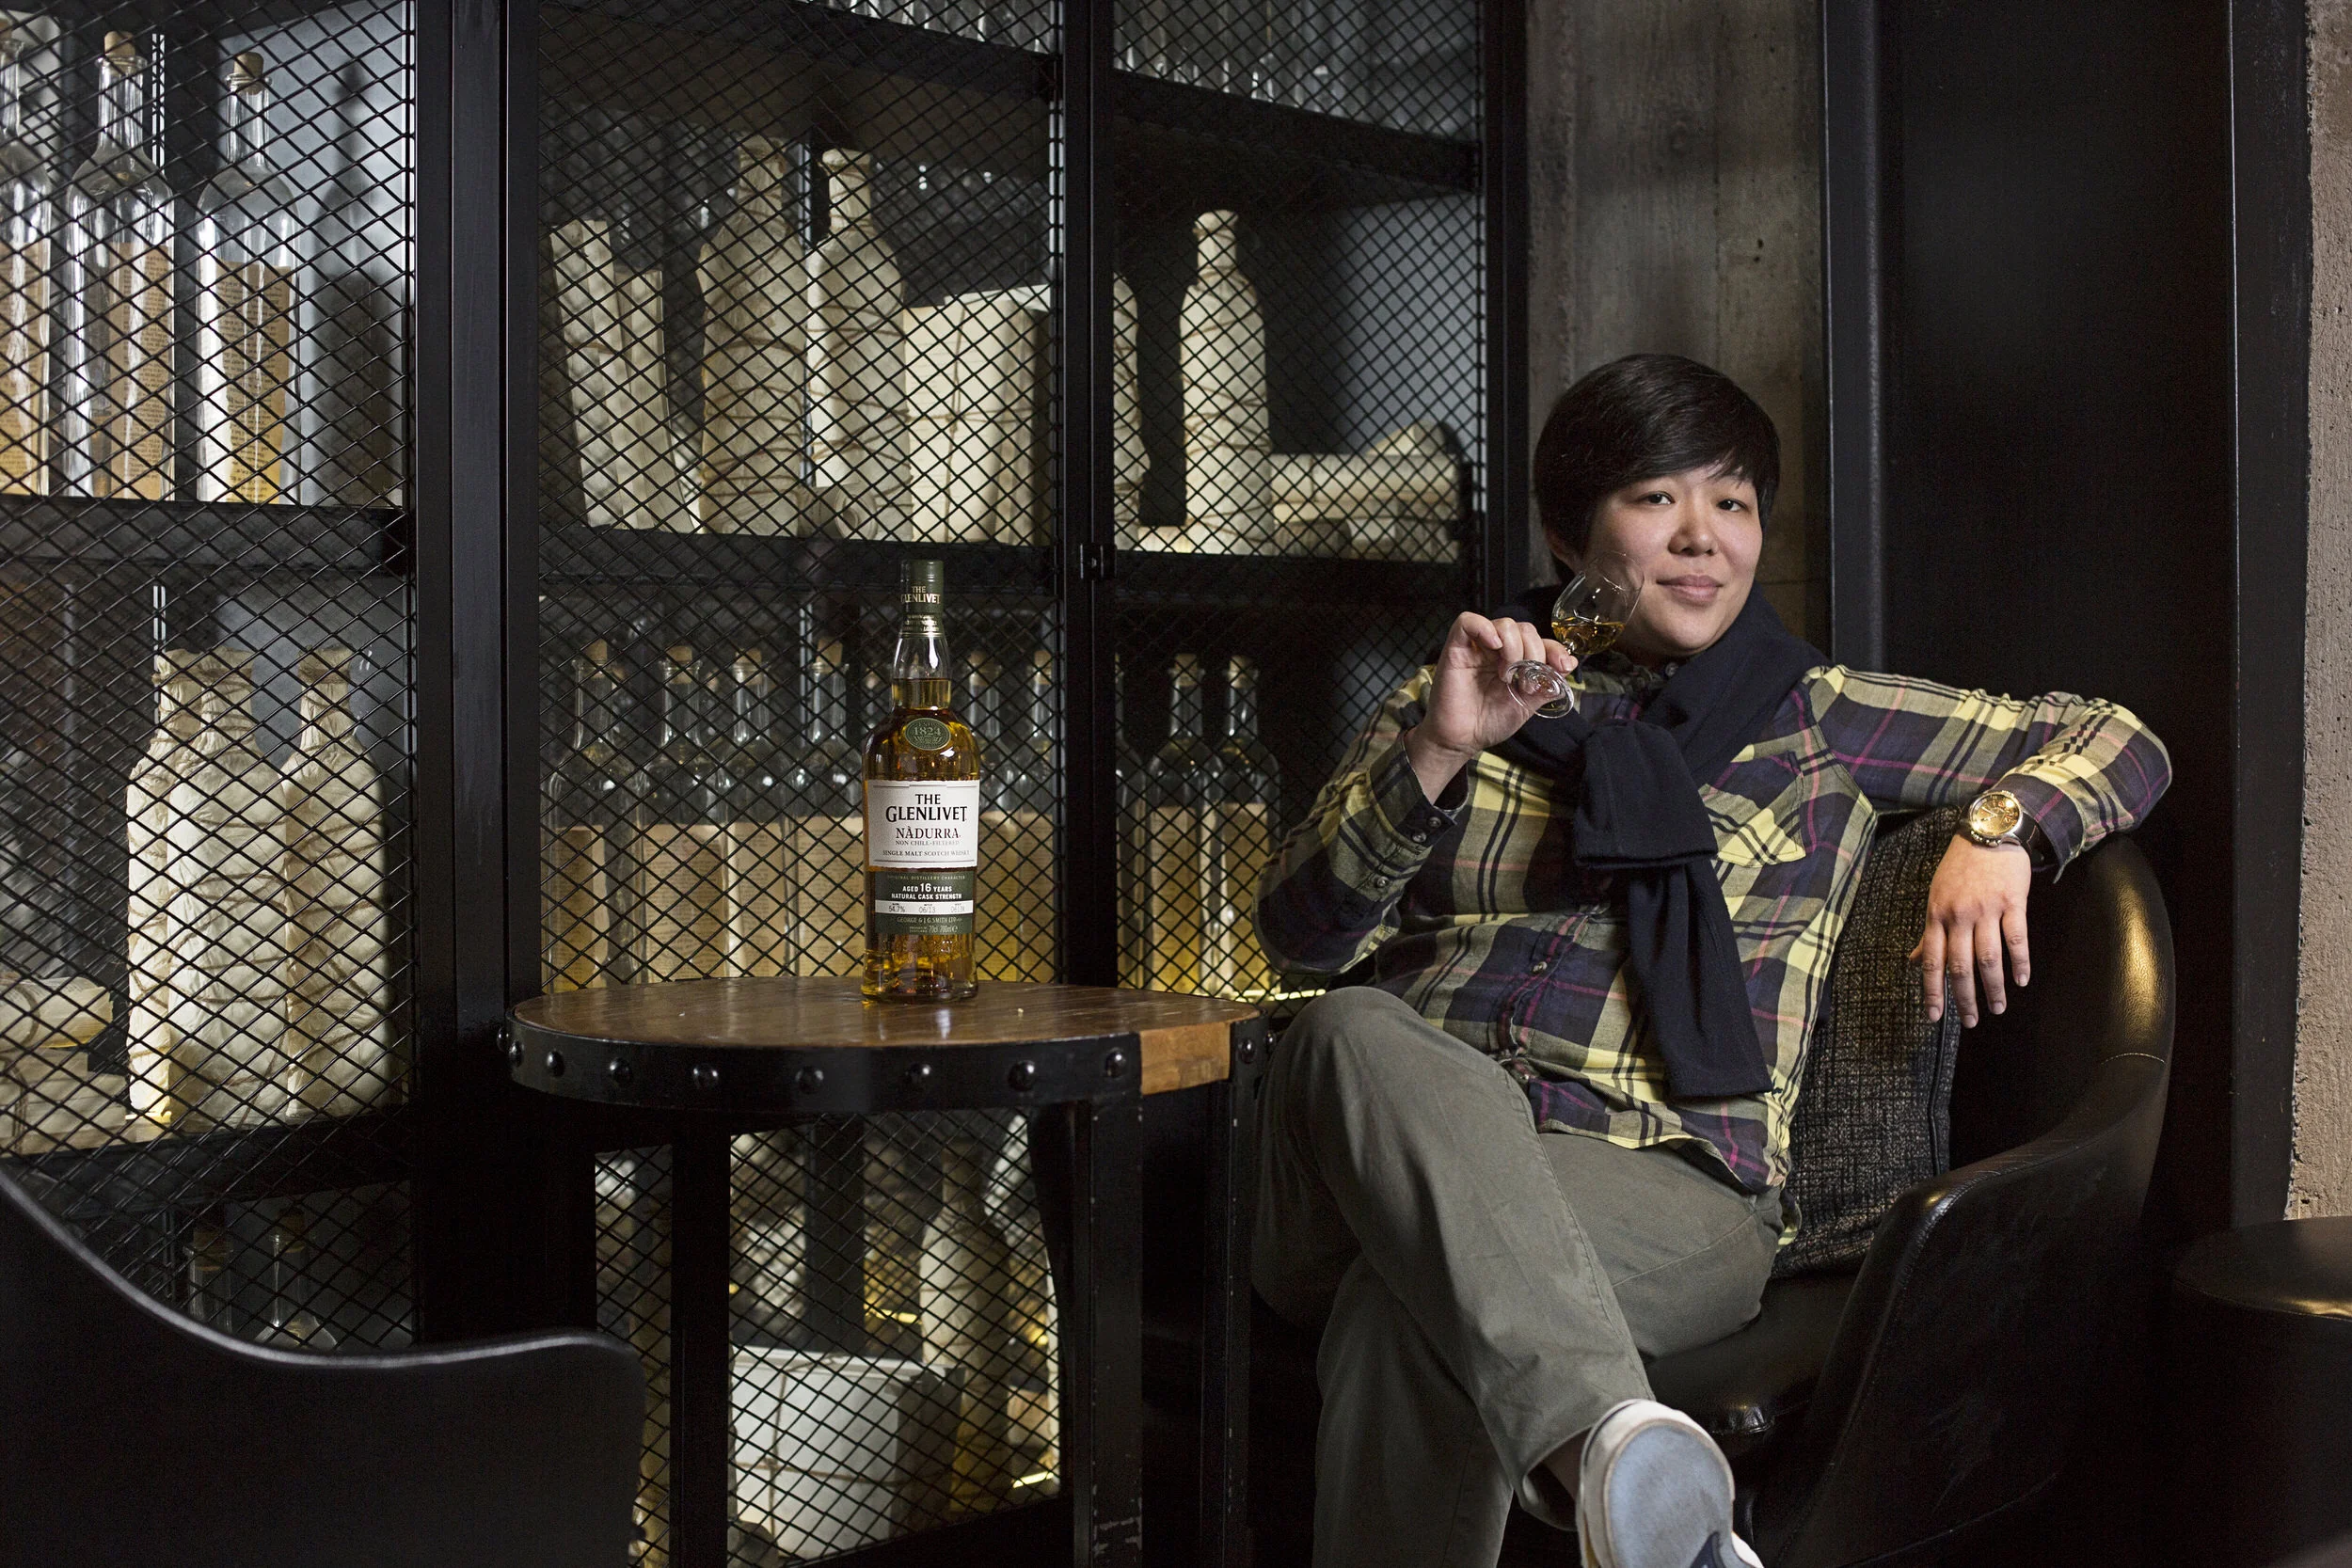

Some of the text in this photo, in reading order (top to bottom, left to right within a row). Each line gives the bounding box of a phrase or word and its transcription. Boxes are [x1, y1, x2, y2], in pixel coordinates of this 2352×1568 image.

[912, 585, 926, 594] THE
[914, 726, 942, 736] 1824
[915, 794, 941, 805] THE
[885, 805, 968, 822] GLENLIVET
[896, 825, 961, 839] NÀDURRA
[920, 883, 931, 893] 16
